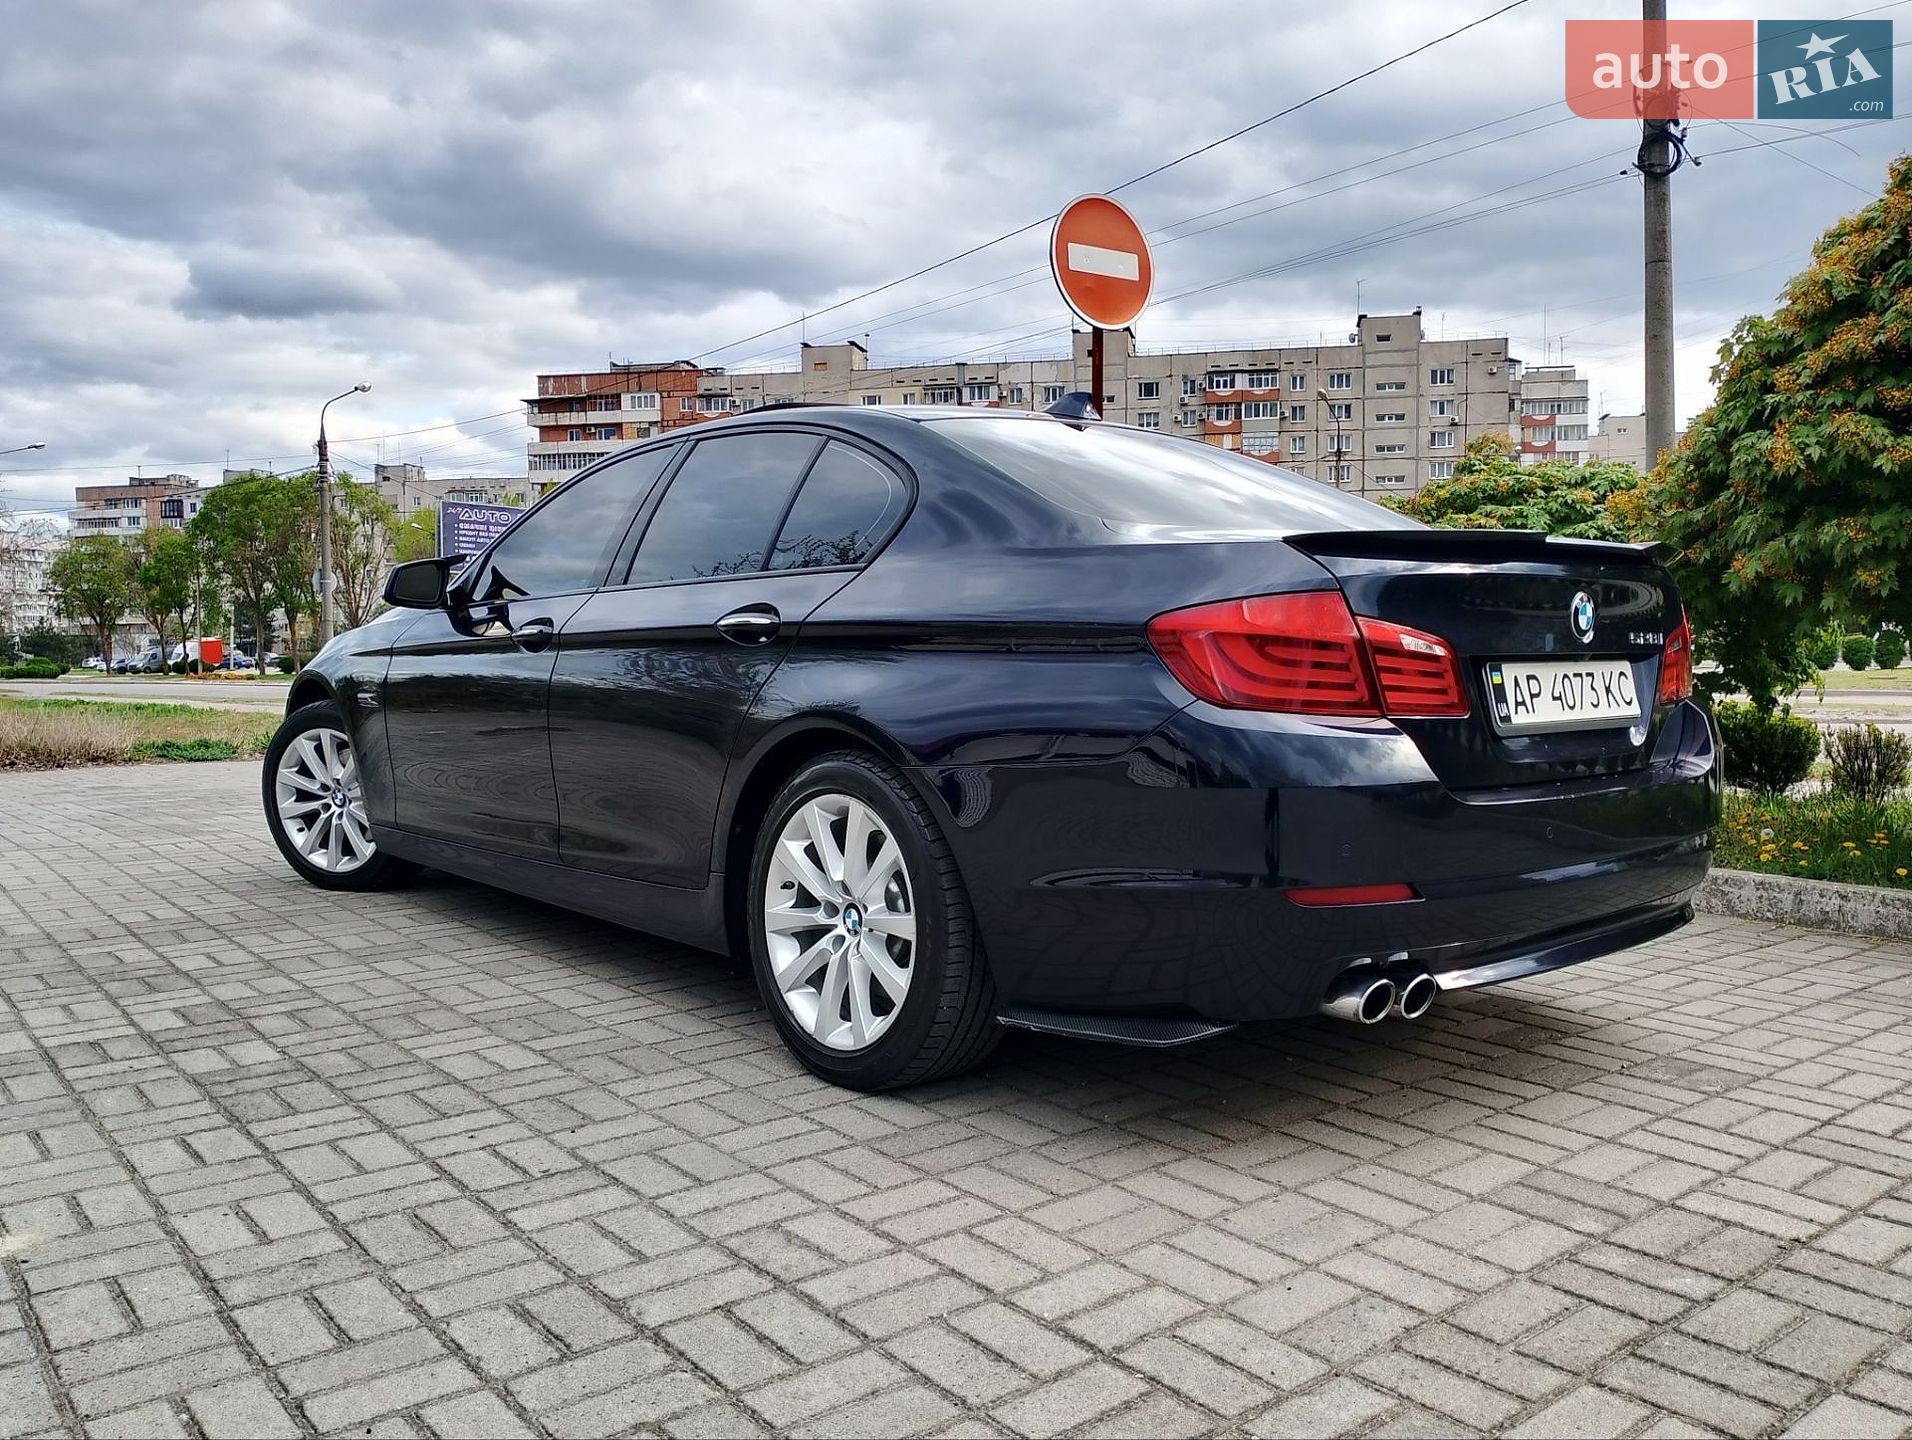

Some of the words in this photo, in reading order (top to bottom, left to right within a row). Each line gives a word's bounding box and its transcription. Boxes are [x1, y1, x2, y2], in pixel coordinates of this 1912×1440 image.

[459, 508, 512, 524] AUTO
[1514, 674, 1541, 715] AP
[1551, 672, 1600, 711] 4073
[1601, 670, 1633, 708] KC
[1498, 703, 1509, 717] UA
